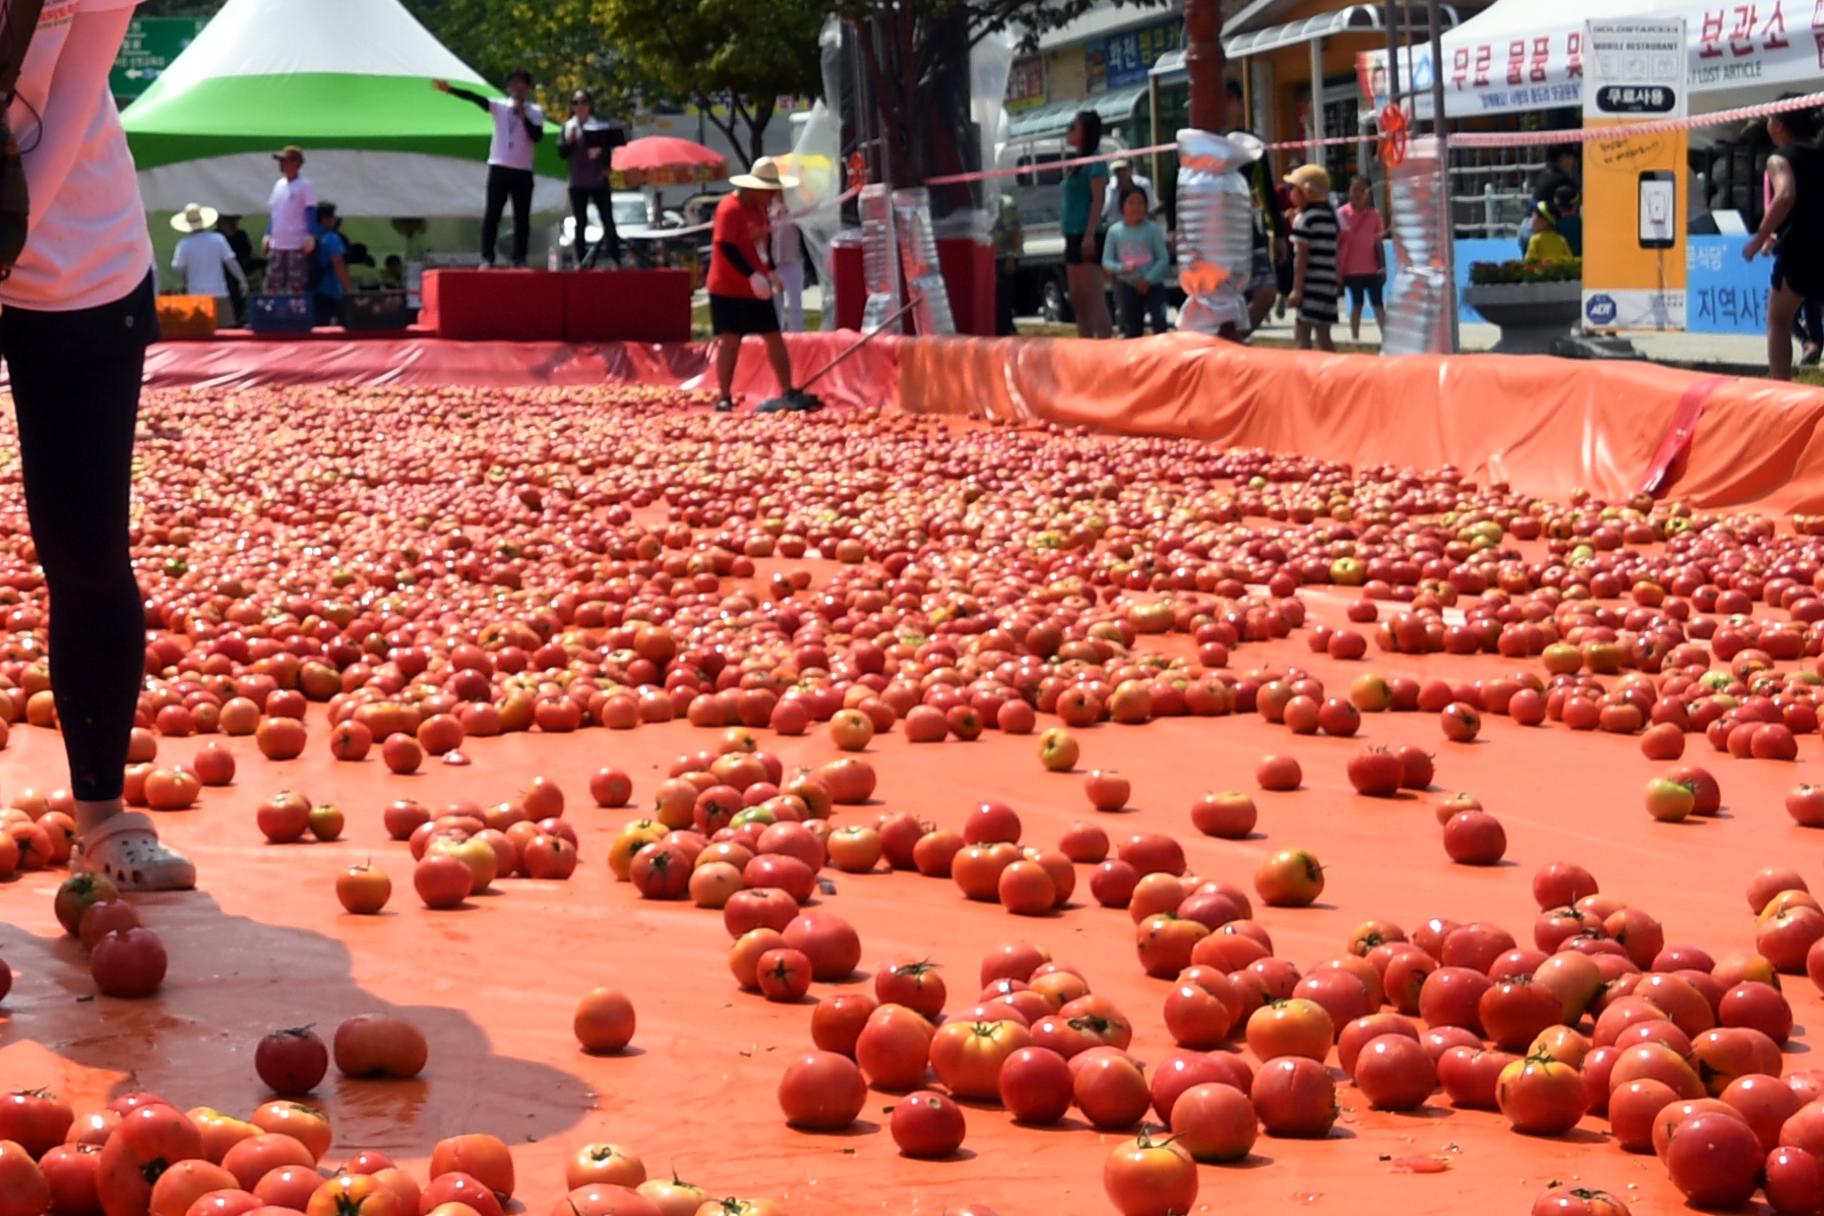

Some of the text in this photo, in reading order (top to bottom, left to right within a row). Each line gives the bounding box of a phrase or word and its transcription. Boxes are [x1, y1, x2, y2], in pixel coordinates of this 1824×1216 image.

[1452, 45, 1491, 91] 무료
[1700, 0, 1789, 59] 보관소
[1723, 60, 1762, 81] ARTICLE
[1698, 287, 1768, 327] 지역사
